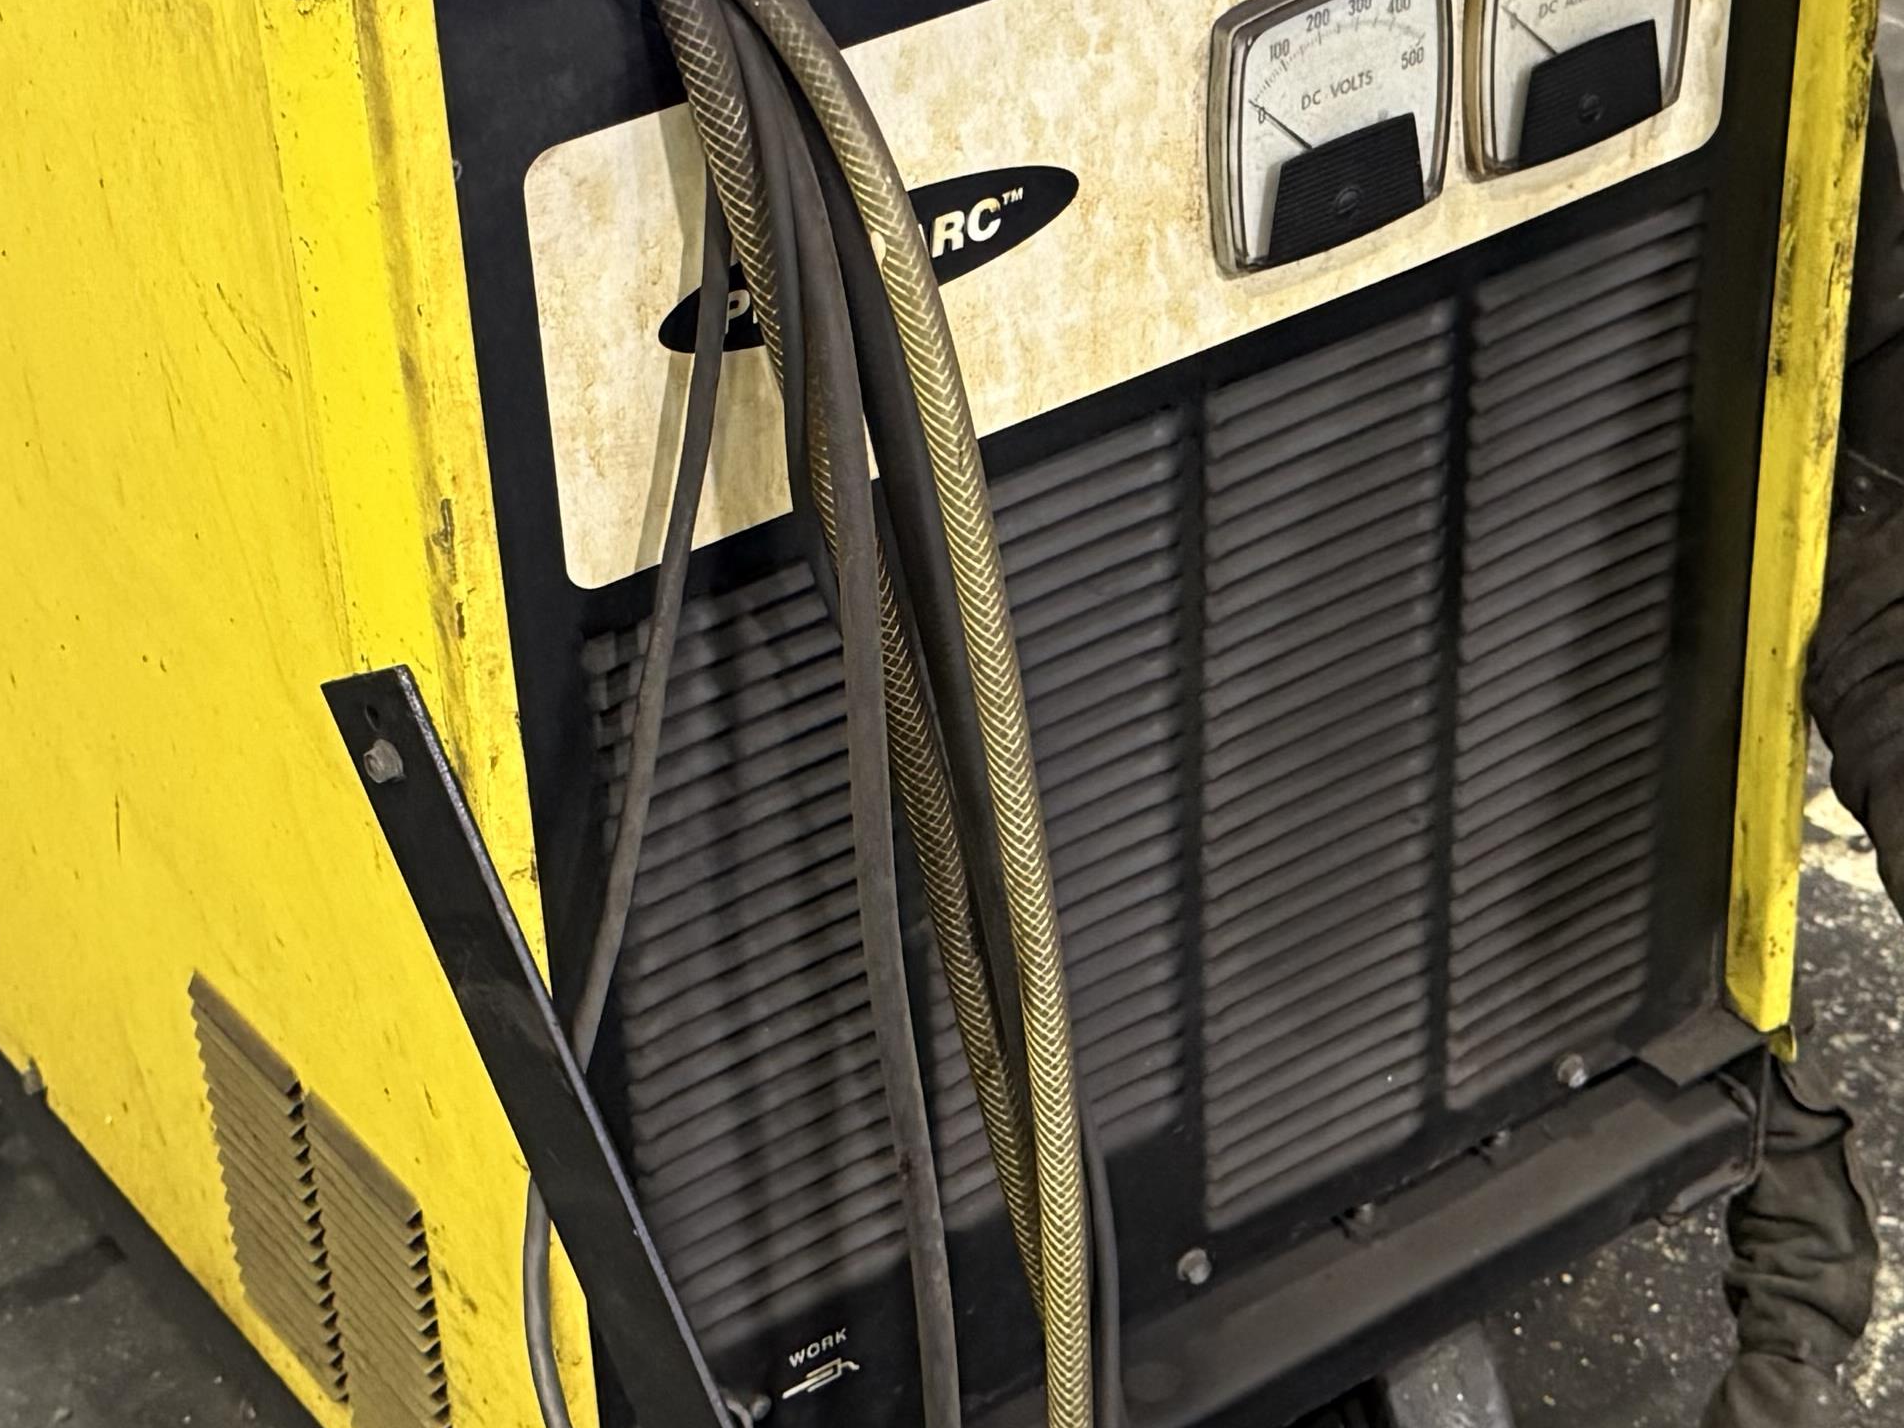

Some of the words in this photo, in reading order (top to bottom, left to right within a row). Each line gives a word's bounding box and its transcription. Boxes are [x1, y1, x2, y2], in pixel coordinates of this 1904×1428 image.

[1306, 8, 1331, 33] 200
[1538, 0, 1558, 19] DC
[1269, 38, 1291, 63] 100
[1401, 45, 1425, 70] 500
[1301, 89, 1321, 111] DC
[1329, 69, 1374, 99] VOLTS
[789, 1328, 847, 1368] WORK
